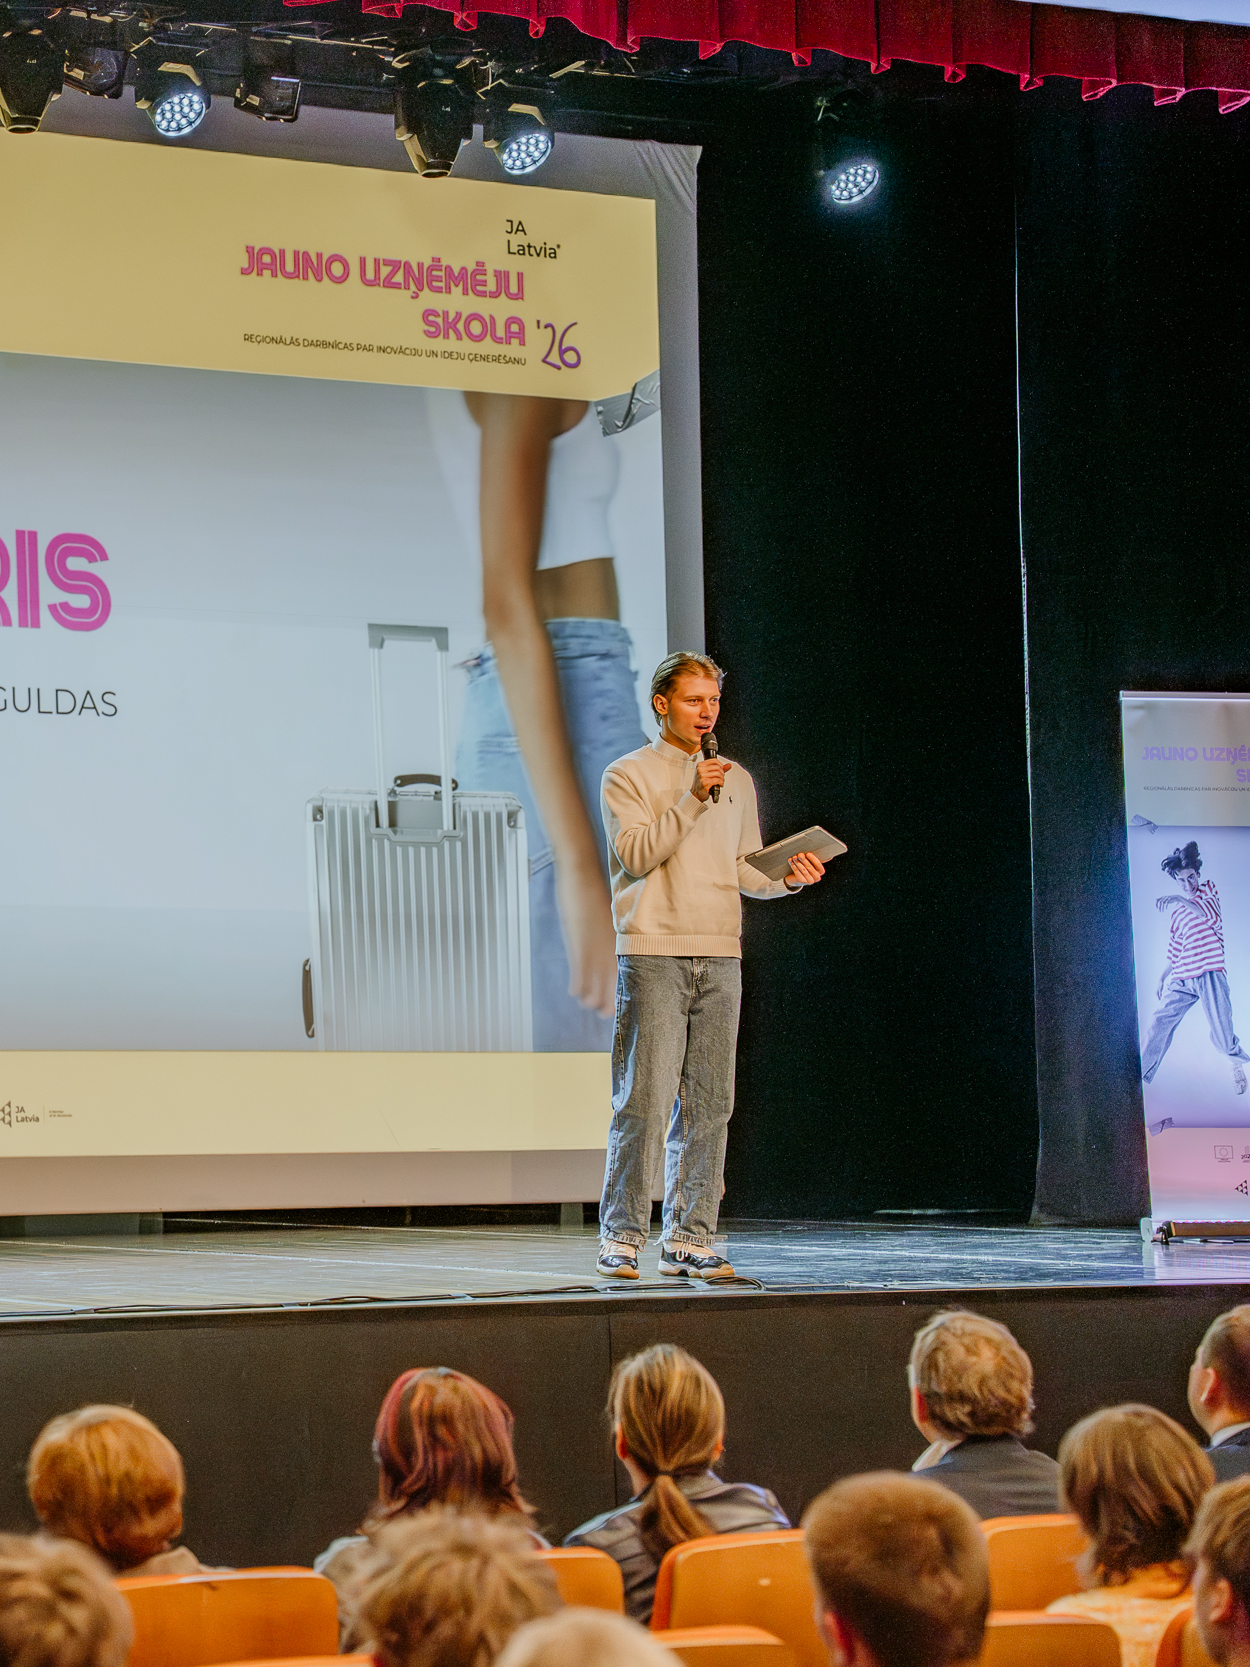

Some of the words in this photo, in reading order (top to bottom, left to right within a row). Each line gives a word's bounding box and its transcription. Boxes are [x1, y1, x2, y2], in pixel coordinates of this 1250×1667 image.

[505, 219, 527, 236] JA
[240, 245, 350, 284] JAUNO
[359, 256, 524, 301] UZŅĒMĒJU
[422, 308, 526, 346] SKOLA
[302, 338, 355, 351] DARBNĪCAS
[356, 342, 375, 353] PAR
[376, 345, 423, 357] INOVĀCIJU
[425, 349, 439, 359] UN
[440, 350, 466, 361] IDEJU
[1141, 746, 1198, 762] JAUNO
[15, 1105, 26, 1114] JA
[15, 1114, 40, 1123] Latvia
